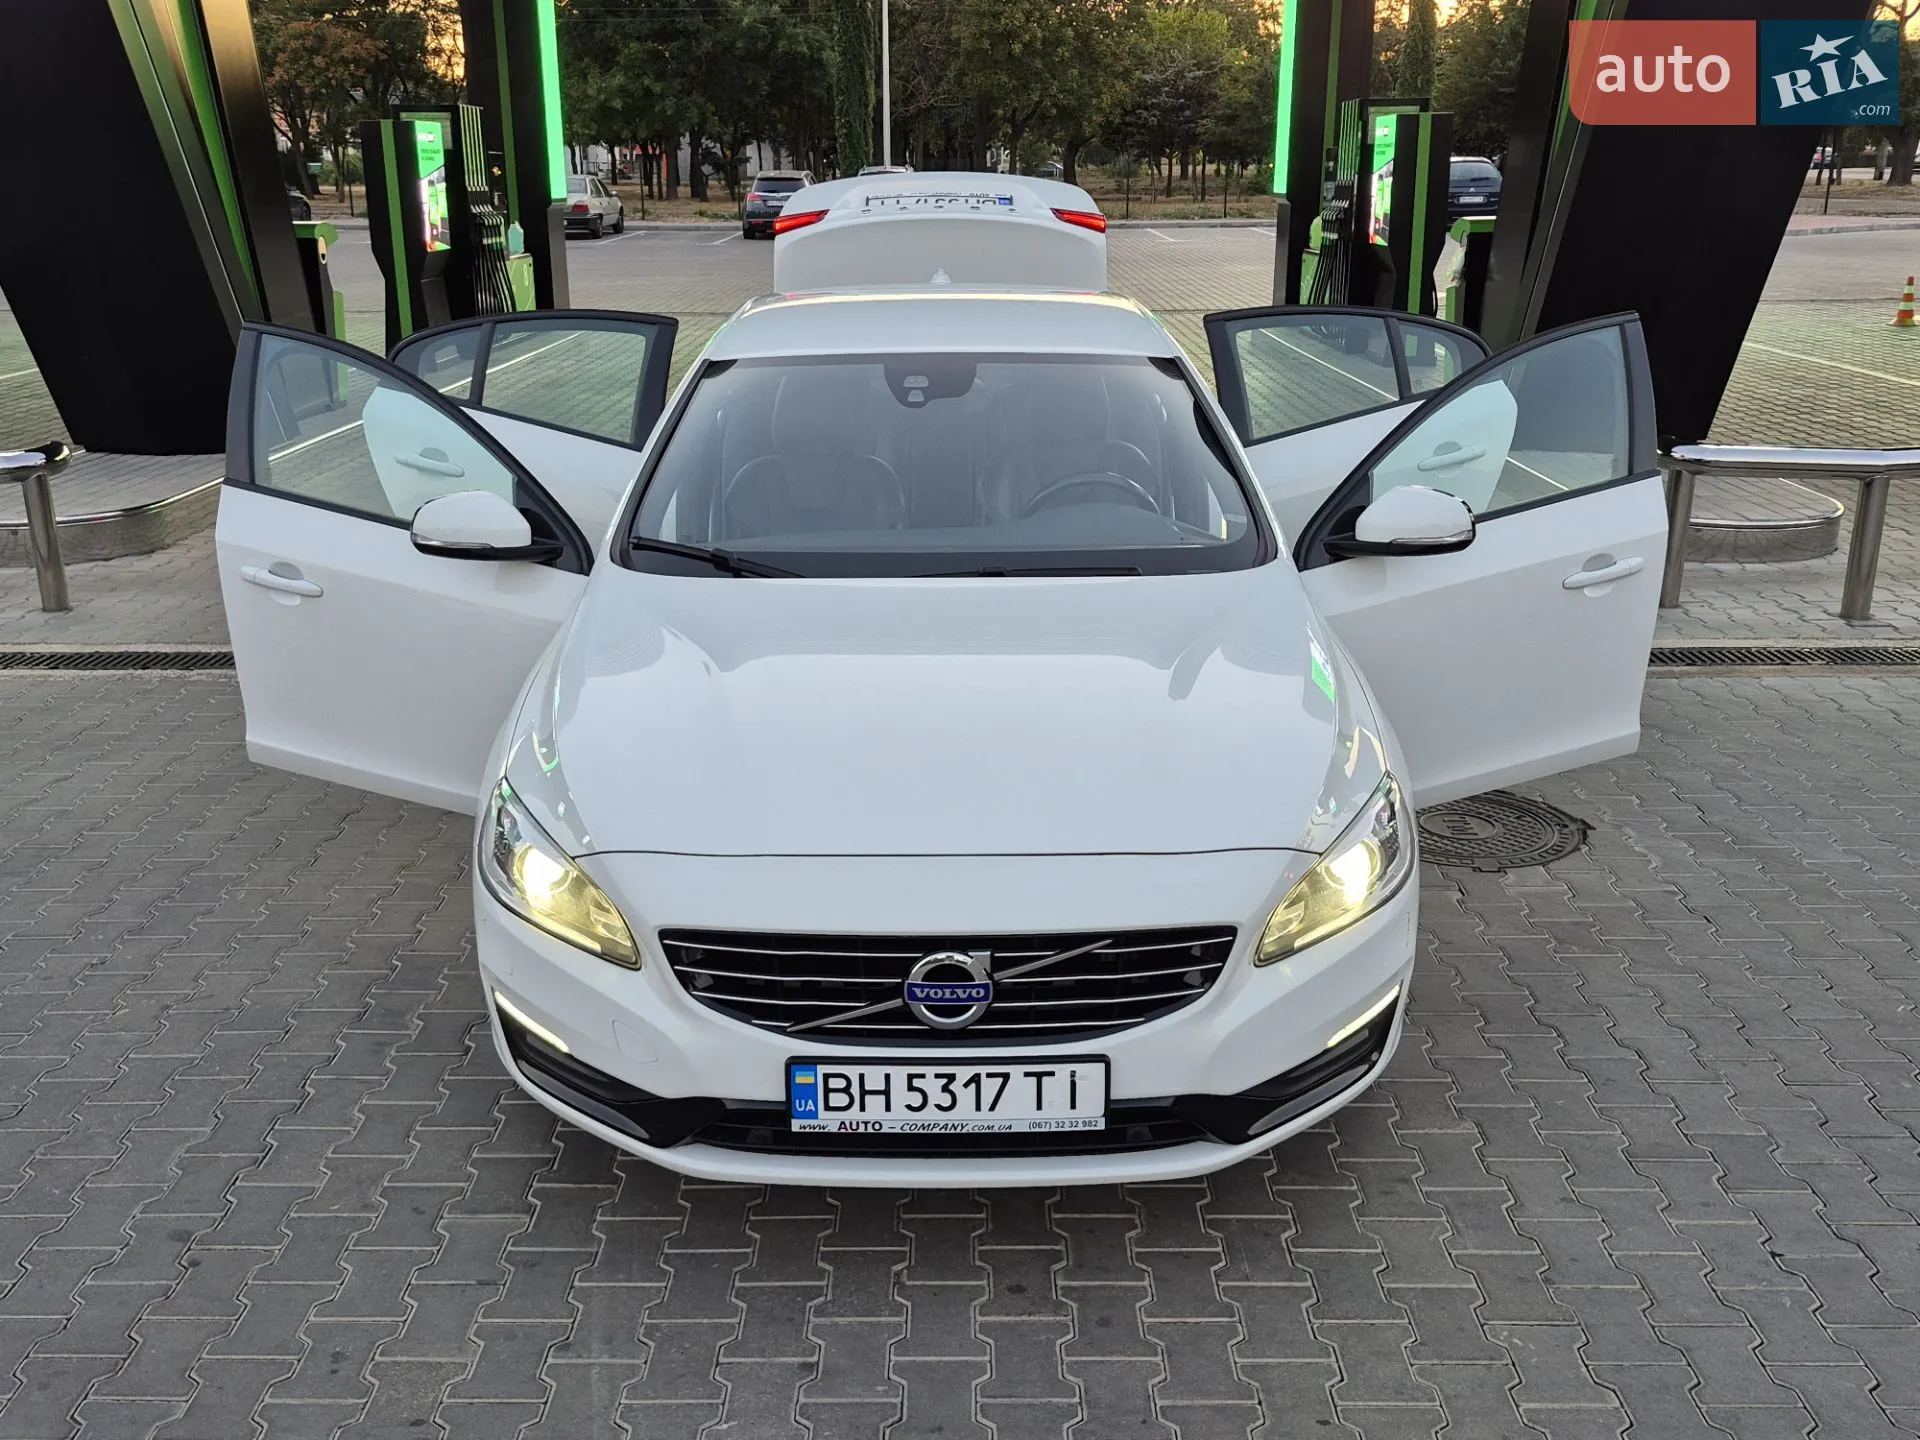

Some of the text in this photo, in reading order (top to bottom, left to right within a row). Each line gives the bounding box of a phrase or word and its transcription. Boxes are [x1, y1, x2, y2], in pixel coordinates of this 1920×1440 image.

[911, 987, 985, 999] VOLVO
[822, 1072, 891, 1112] BH
[904, 1071, 1011, 1113] 5317
[795, 1099, 815, 1112] UA
[837, 1121, 883, 1132] AUTO
[1028, 1119, 1099, 1130] (067) 32 32 982
